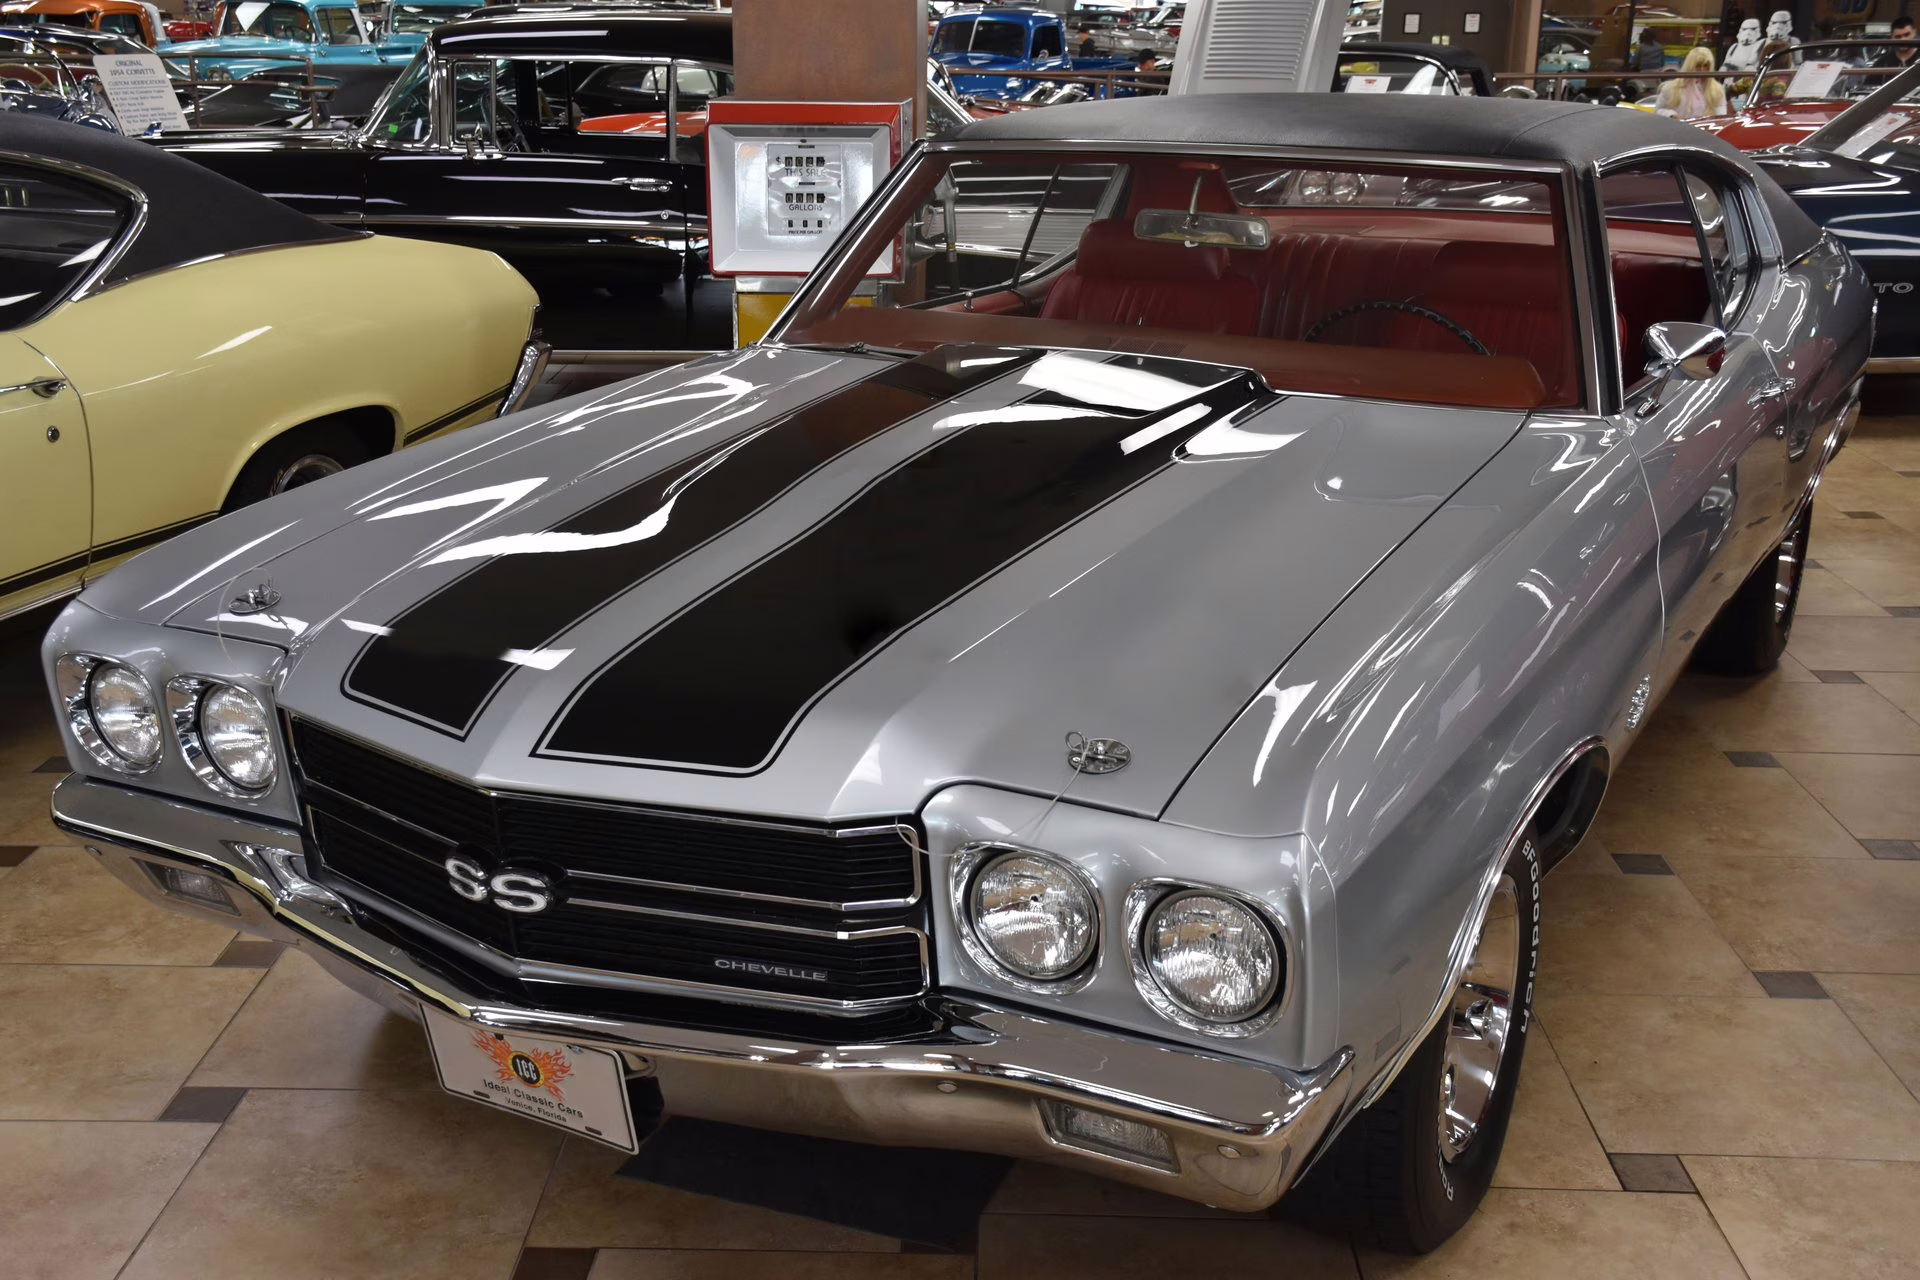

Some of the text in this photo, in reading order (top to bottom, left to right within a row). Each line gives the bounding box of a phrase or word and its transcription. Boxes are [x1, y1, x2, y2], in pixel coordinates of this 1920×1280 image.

[115, 59, 142, 67] ORIGINAL
[126, 68, 155, 76] CORVETTE
[785, 168, 803, 176] THIS
[1873, 282, 1914, 293] TO
[445, 858, 547, 912] SS
[1521, 839, 1540, 1033] BFGoodrich
[714, 959, 827, 981] CHEVELLE
[516, 1058, 538, 1081] ICC
[483, 1079, 583, 1119] Ideal Classic Cars
[537, 1107, 567, 1123] Florida
